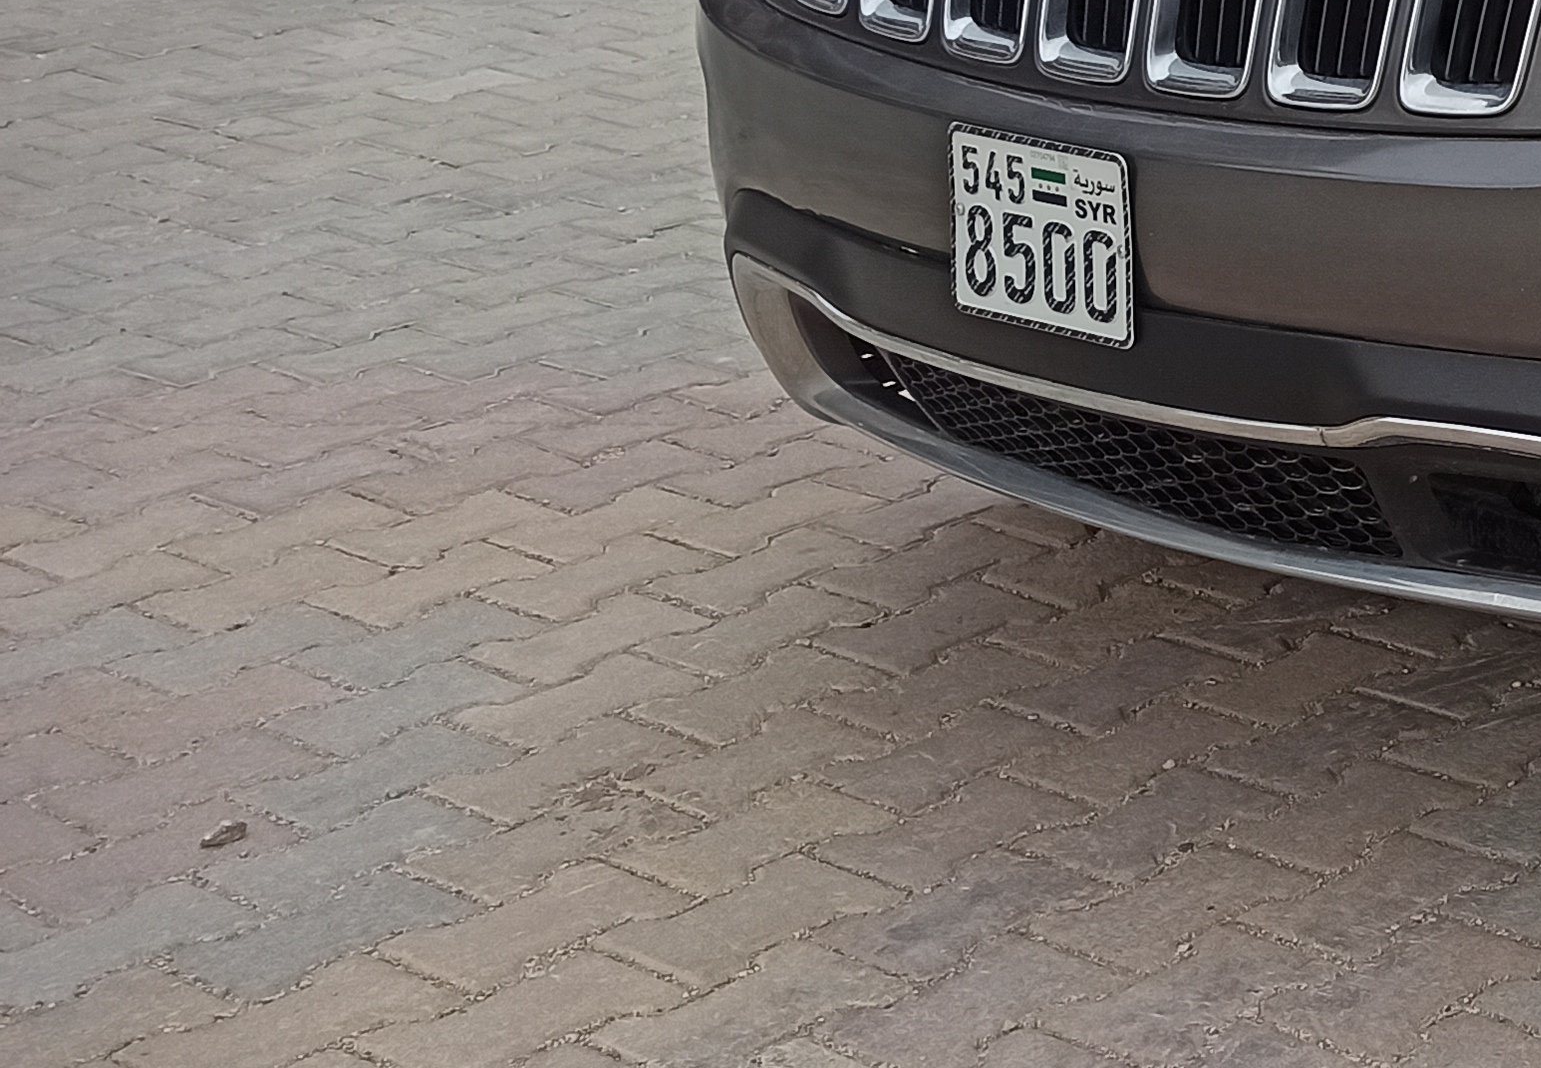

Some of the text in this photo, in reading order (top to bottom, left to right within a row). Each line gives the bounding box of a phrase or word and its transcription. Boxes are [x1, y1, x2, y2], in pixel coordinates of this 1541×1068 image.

[961, 145, 1026, 205] 545
[1072, 168, 1116, 196] سورية
[1074, 199, 1117, 225] SYR
[965, 205, 1118, 324] 8500
